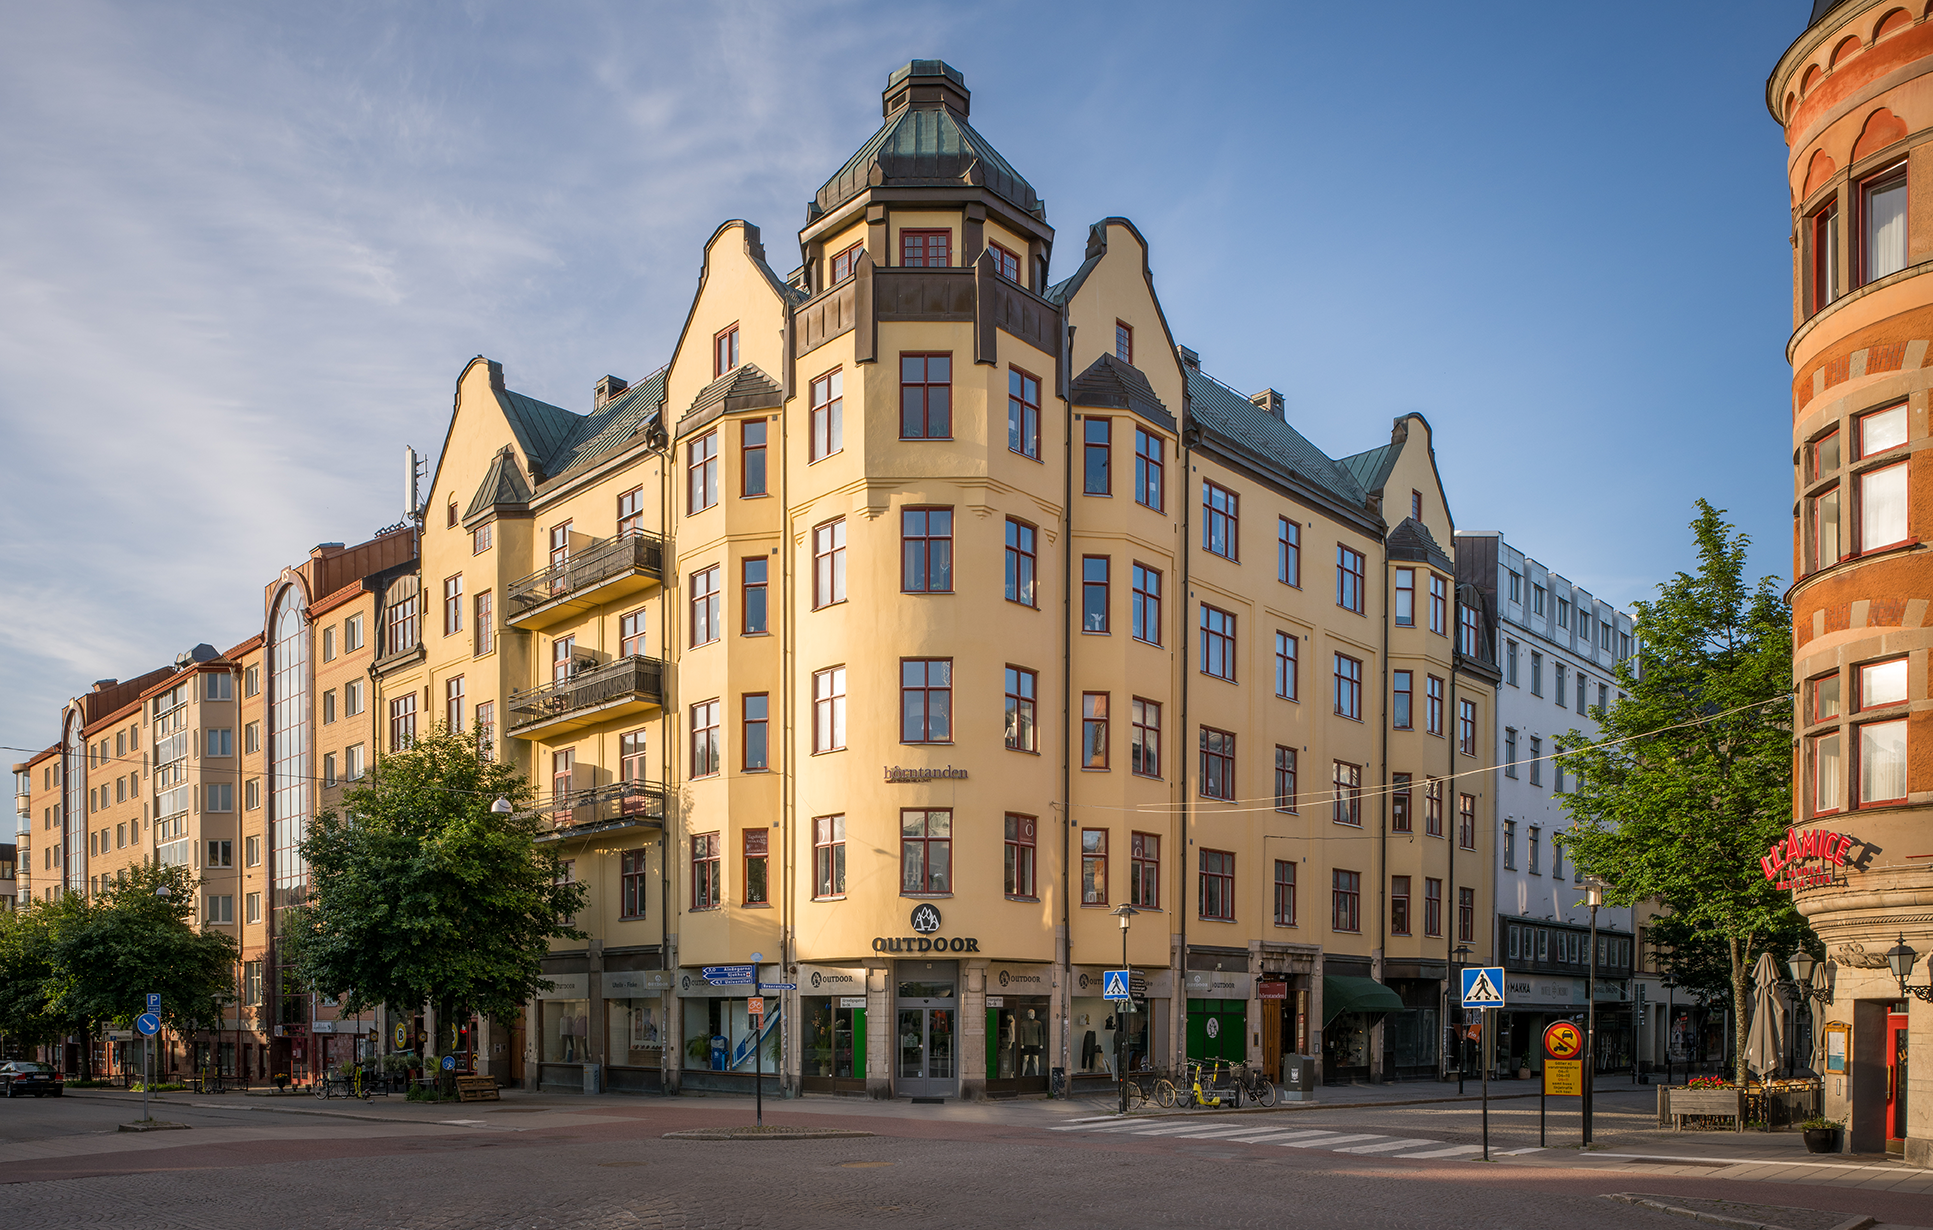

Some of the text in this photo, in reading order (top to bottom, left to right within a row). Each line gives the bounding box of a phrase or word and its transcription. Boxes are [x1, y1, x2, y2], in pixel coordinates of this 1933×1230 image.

[1786, 865, 1824, 878] TAVOLA
[1776, 874, 1833, 890] DELLA VITA
[871, 937, 980, 953] OUTDOOR
[823, 975, 853, 983] OUTDOOR
[1011, 975, 1041, 983] OUTDOOR
[1510, 982, 1531, 994] MAKKA
[150, 995, 158, 1005] P
